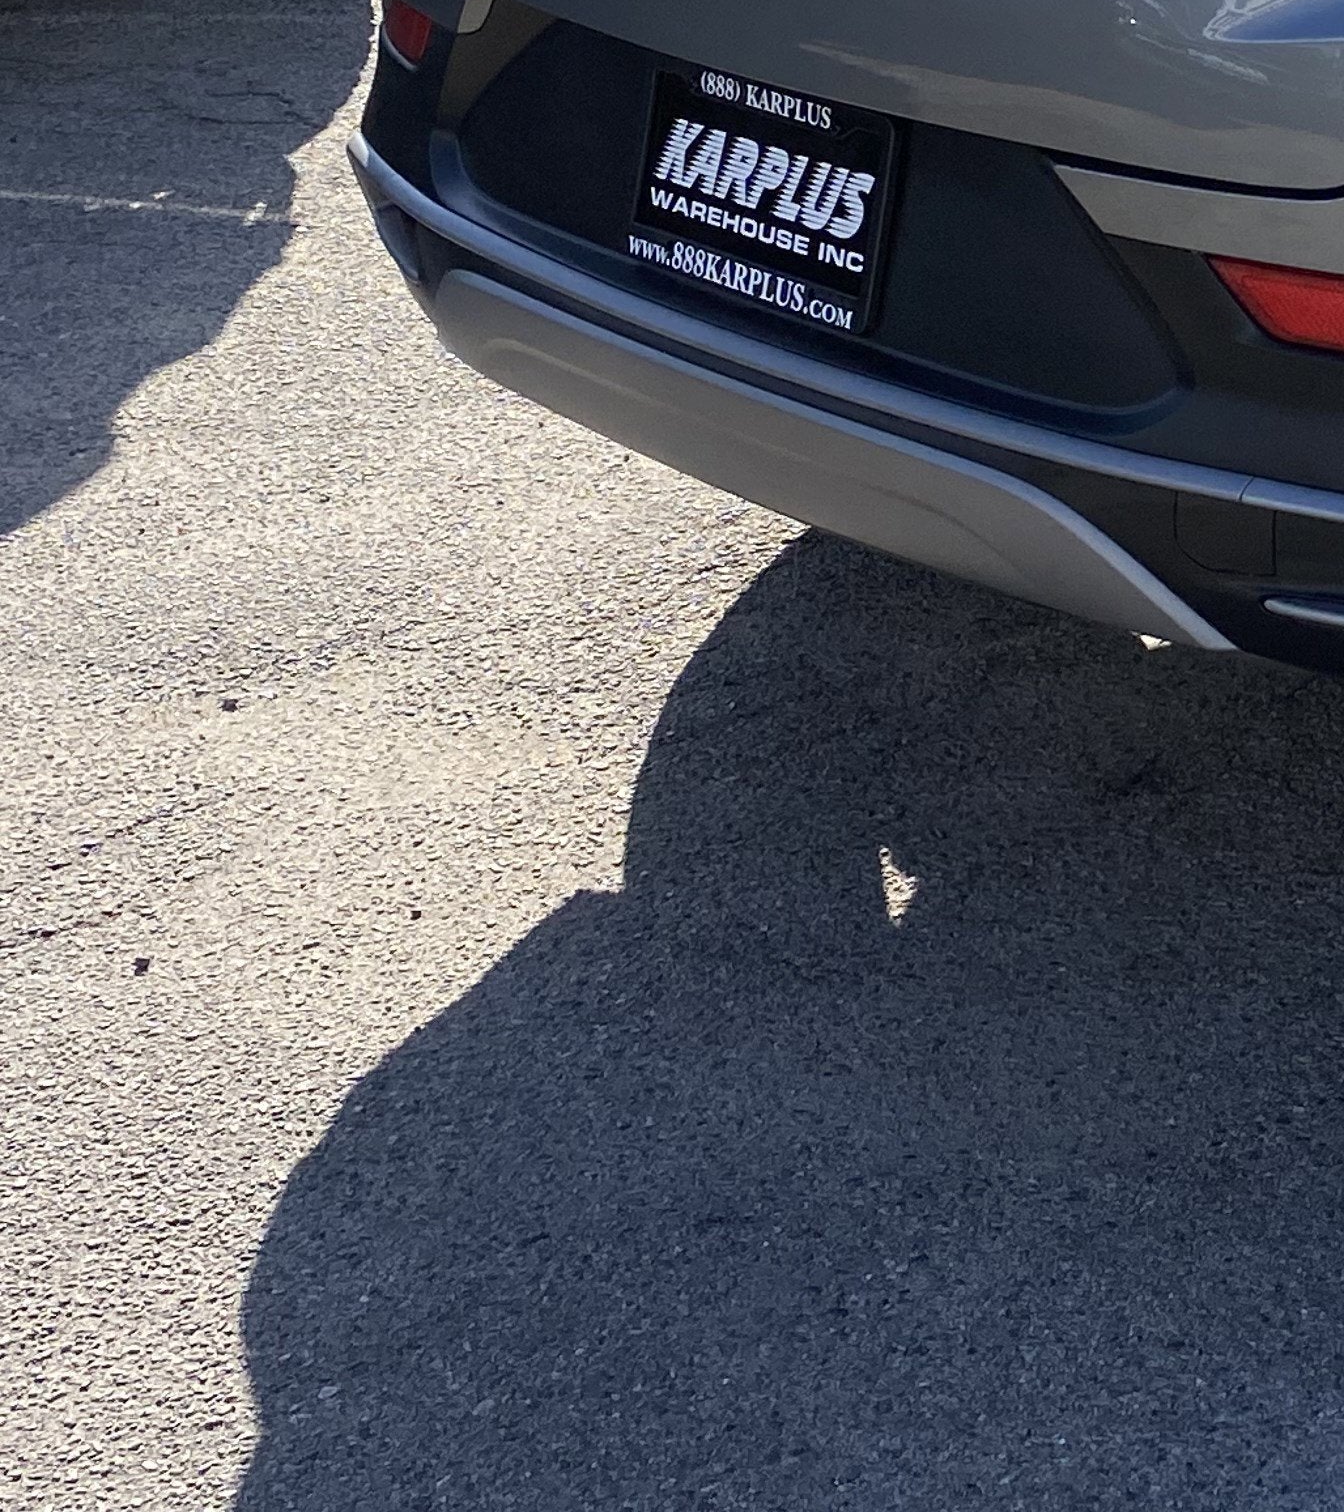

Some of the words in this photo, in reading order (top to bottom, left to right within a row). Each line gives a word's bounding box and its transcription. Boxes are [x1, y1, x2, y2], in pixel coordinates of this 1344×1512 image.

[700, 71, 741, 102] (888)
[745, 84, 832, 130] KARPLUS
[653, 118, 876, 239] KARPLUS
[650, 186, 809, 256] WAREHOUSE
[817, 242, 865, 273] INC
